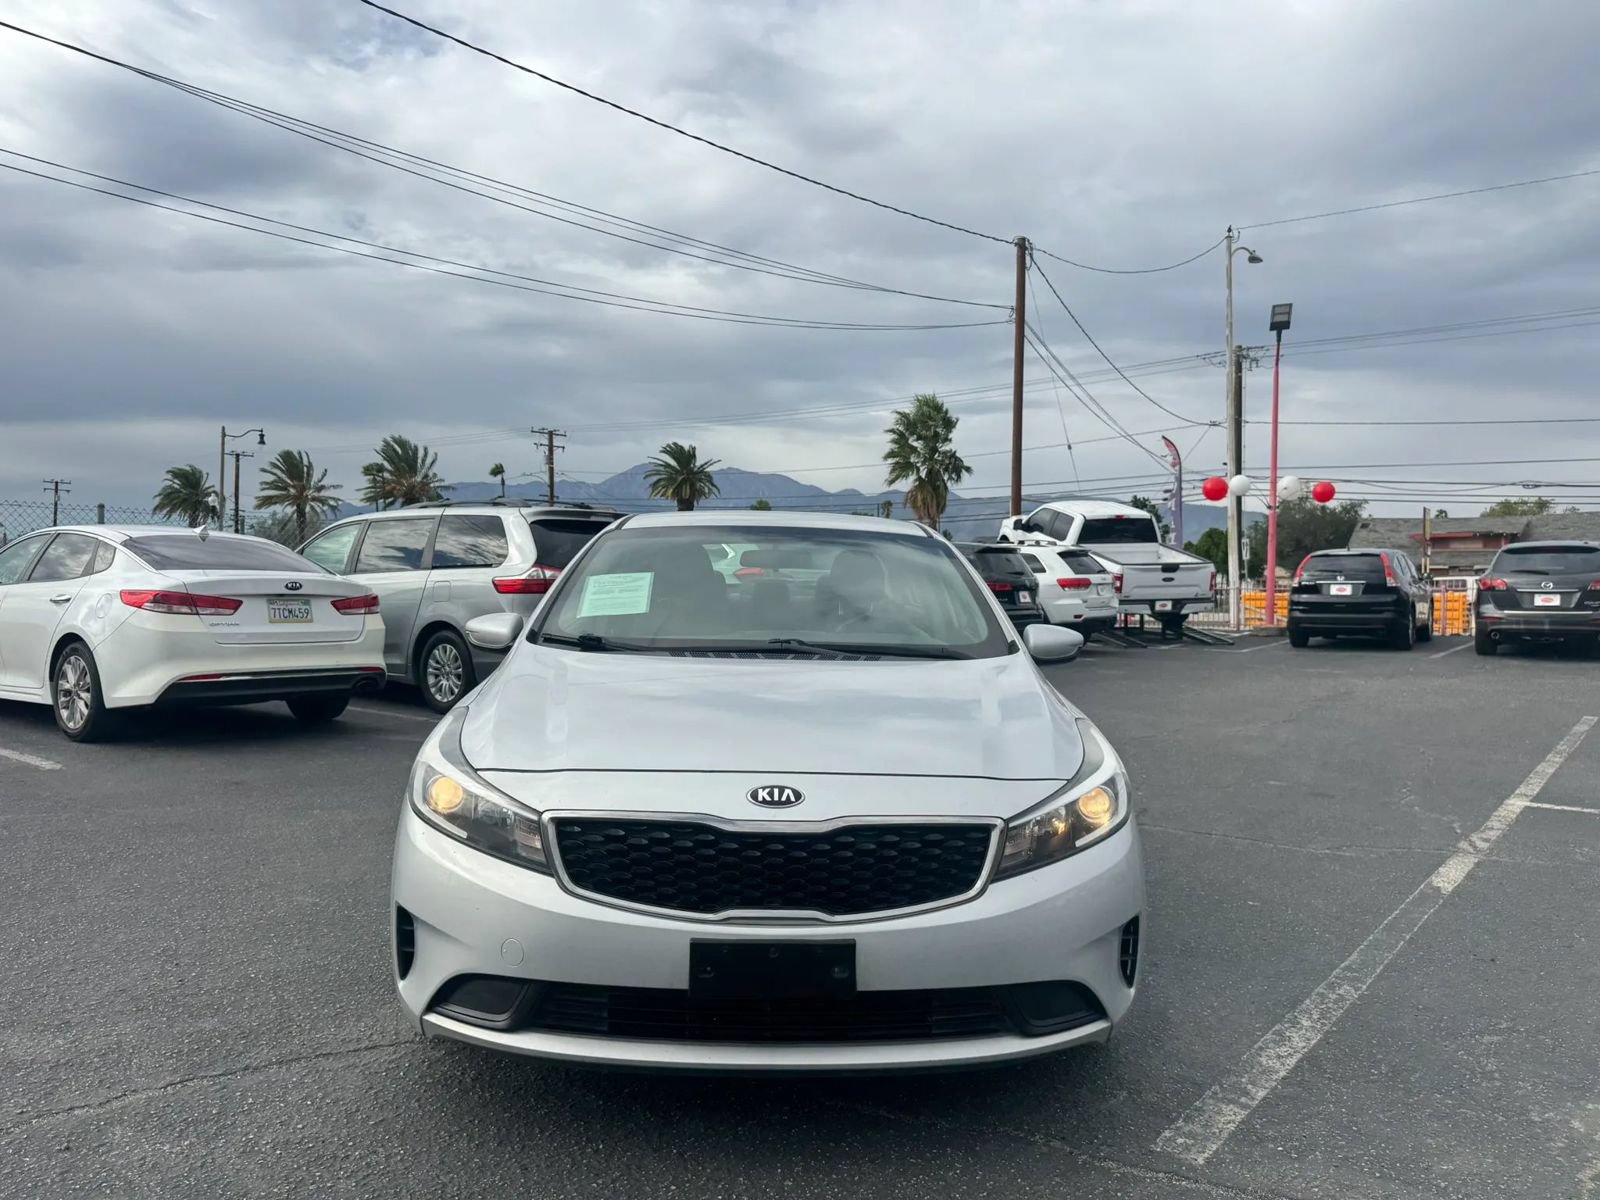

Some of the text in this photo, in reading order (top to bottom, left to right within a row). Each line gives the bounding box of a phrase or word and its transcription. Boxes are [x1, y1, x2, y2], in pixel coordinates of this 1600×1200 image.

[286, 582, 301, 590] KIA
[271, 607, 310, 619] 7TCM459
[756, 786, 797, 803] KIA
